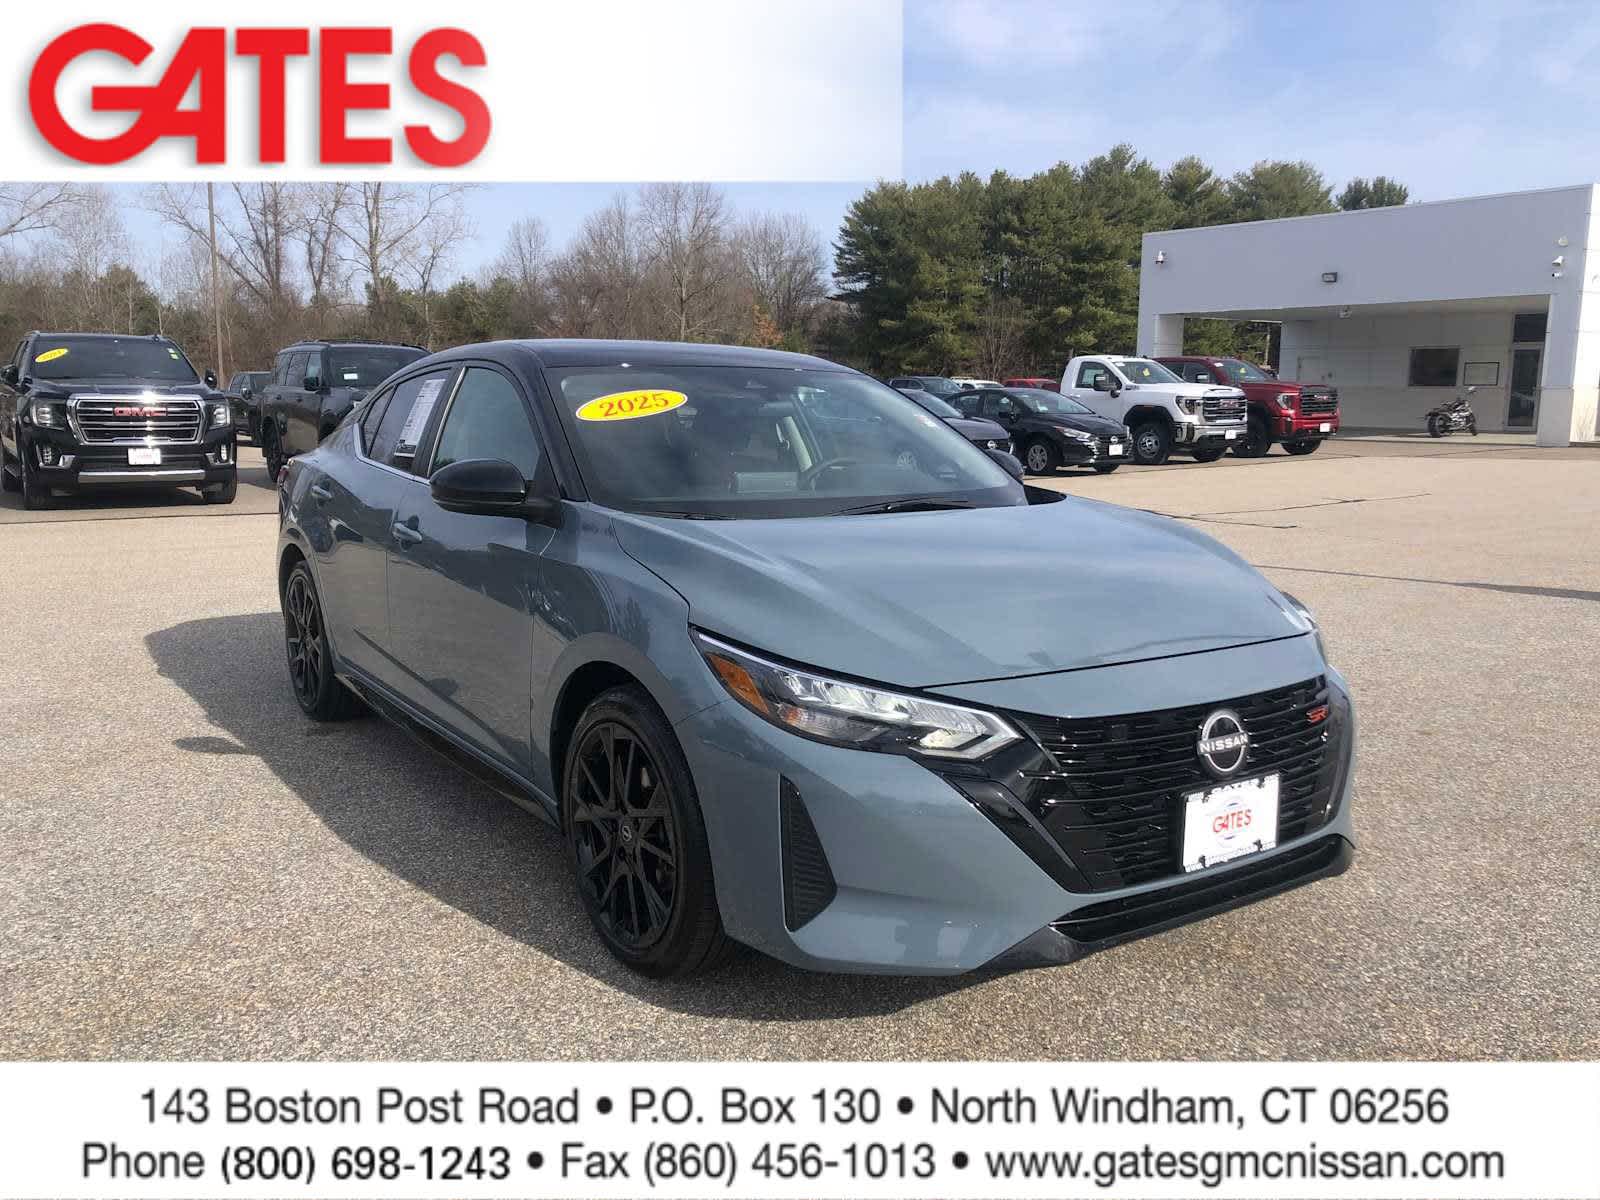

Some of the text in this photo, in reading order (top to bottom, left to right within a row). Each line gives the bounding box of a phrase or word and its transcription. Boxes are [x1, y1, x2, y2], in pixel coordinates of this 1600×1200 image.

[599, 393, 669, 417] 2025
[1199, 733, 1249, 753] NISSAN
[1212, 809, 1252, 833] GATES
